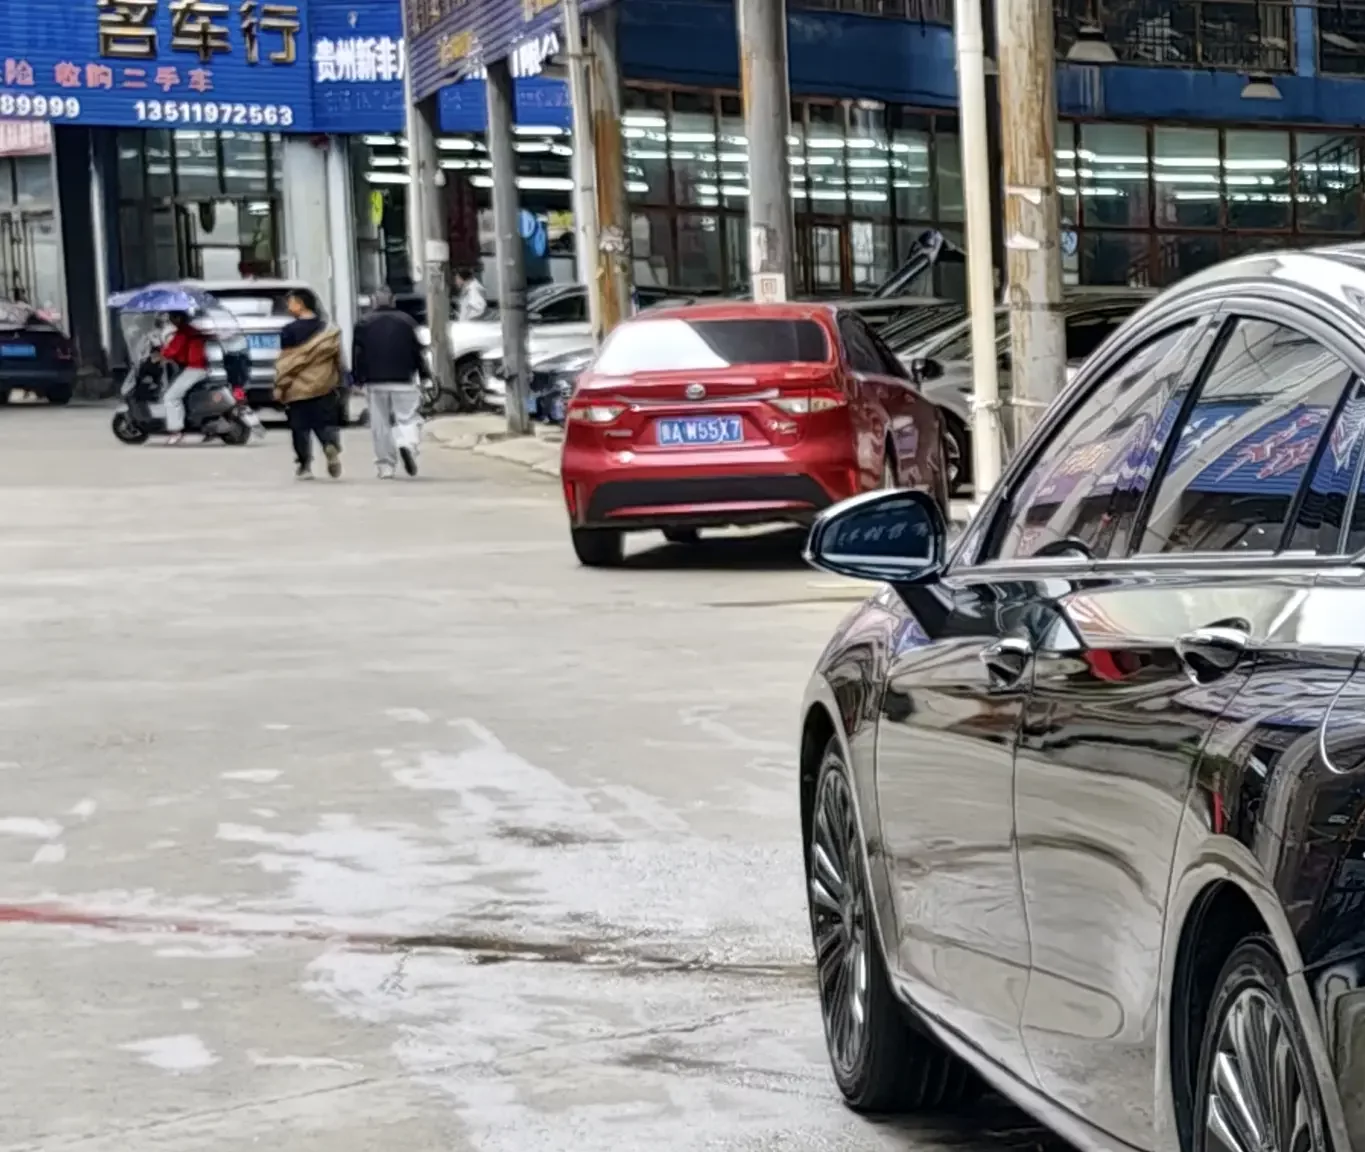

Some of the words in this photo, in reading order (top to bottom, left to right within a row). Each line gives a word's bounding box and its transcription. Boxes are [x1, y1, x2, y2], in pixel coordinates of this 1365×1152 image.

[97, 0, 299, 63] 名车行
[0, 57, 34, 86] 险
[54, 60, 213, 92] 收购二手车
[134, 101, 293, 126] 13511972563
